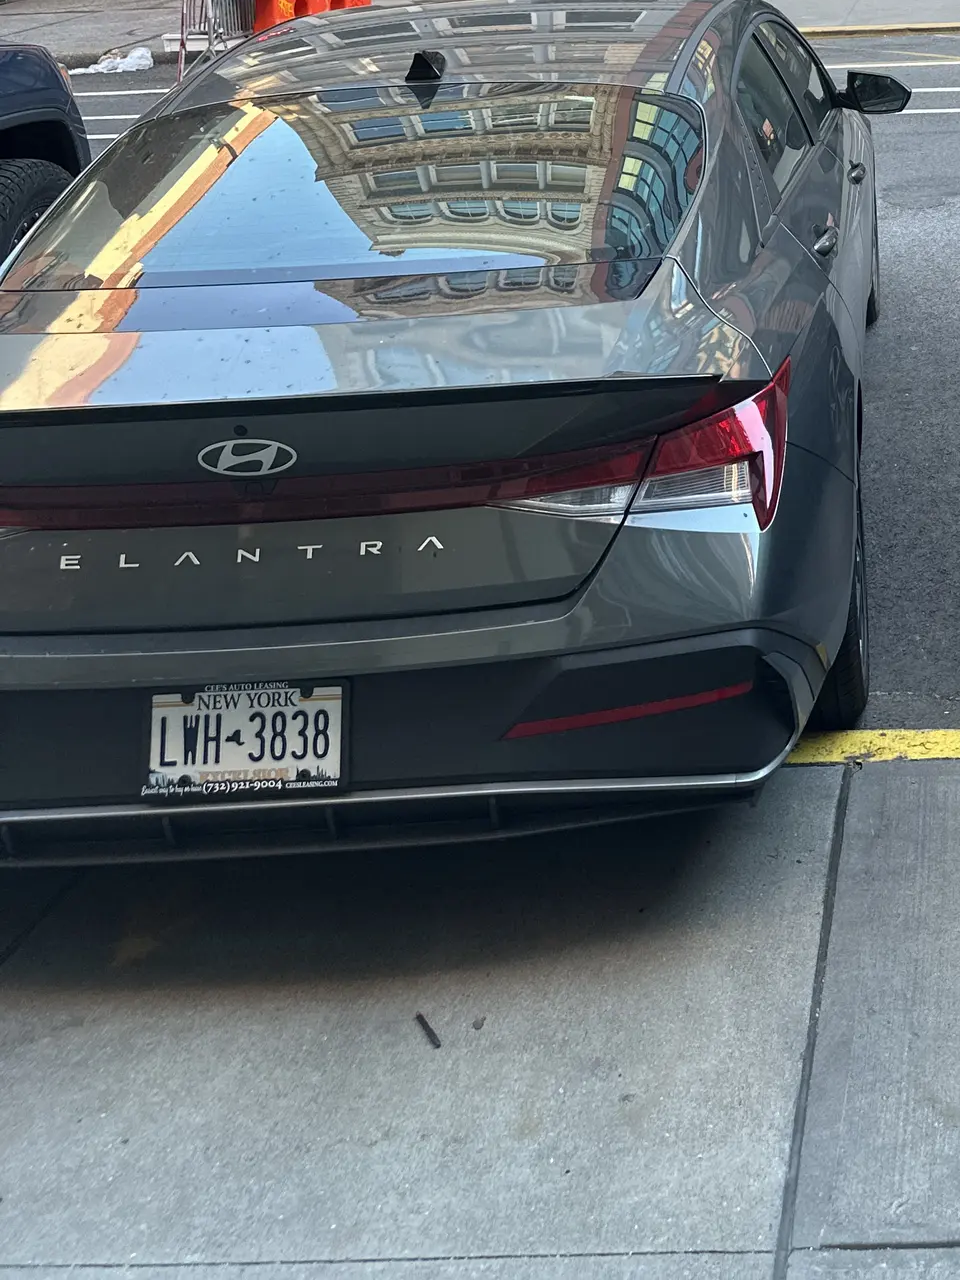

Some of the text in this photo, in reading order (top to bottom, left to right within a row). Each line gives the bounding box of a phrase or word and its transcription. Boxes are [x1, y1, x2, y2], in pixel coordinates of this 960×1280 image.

[59, 536, 444, 570] ELANTRA
[229, 683, 252, 691] AUTO
[254, 681, 288, 690] LEASING
[197, 690, 298, 711] NEW YORK
[159, 709, 330, 767] LWH 3838
